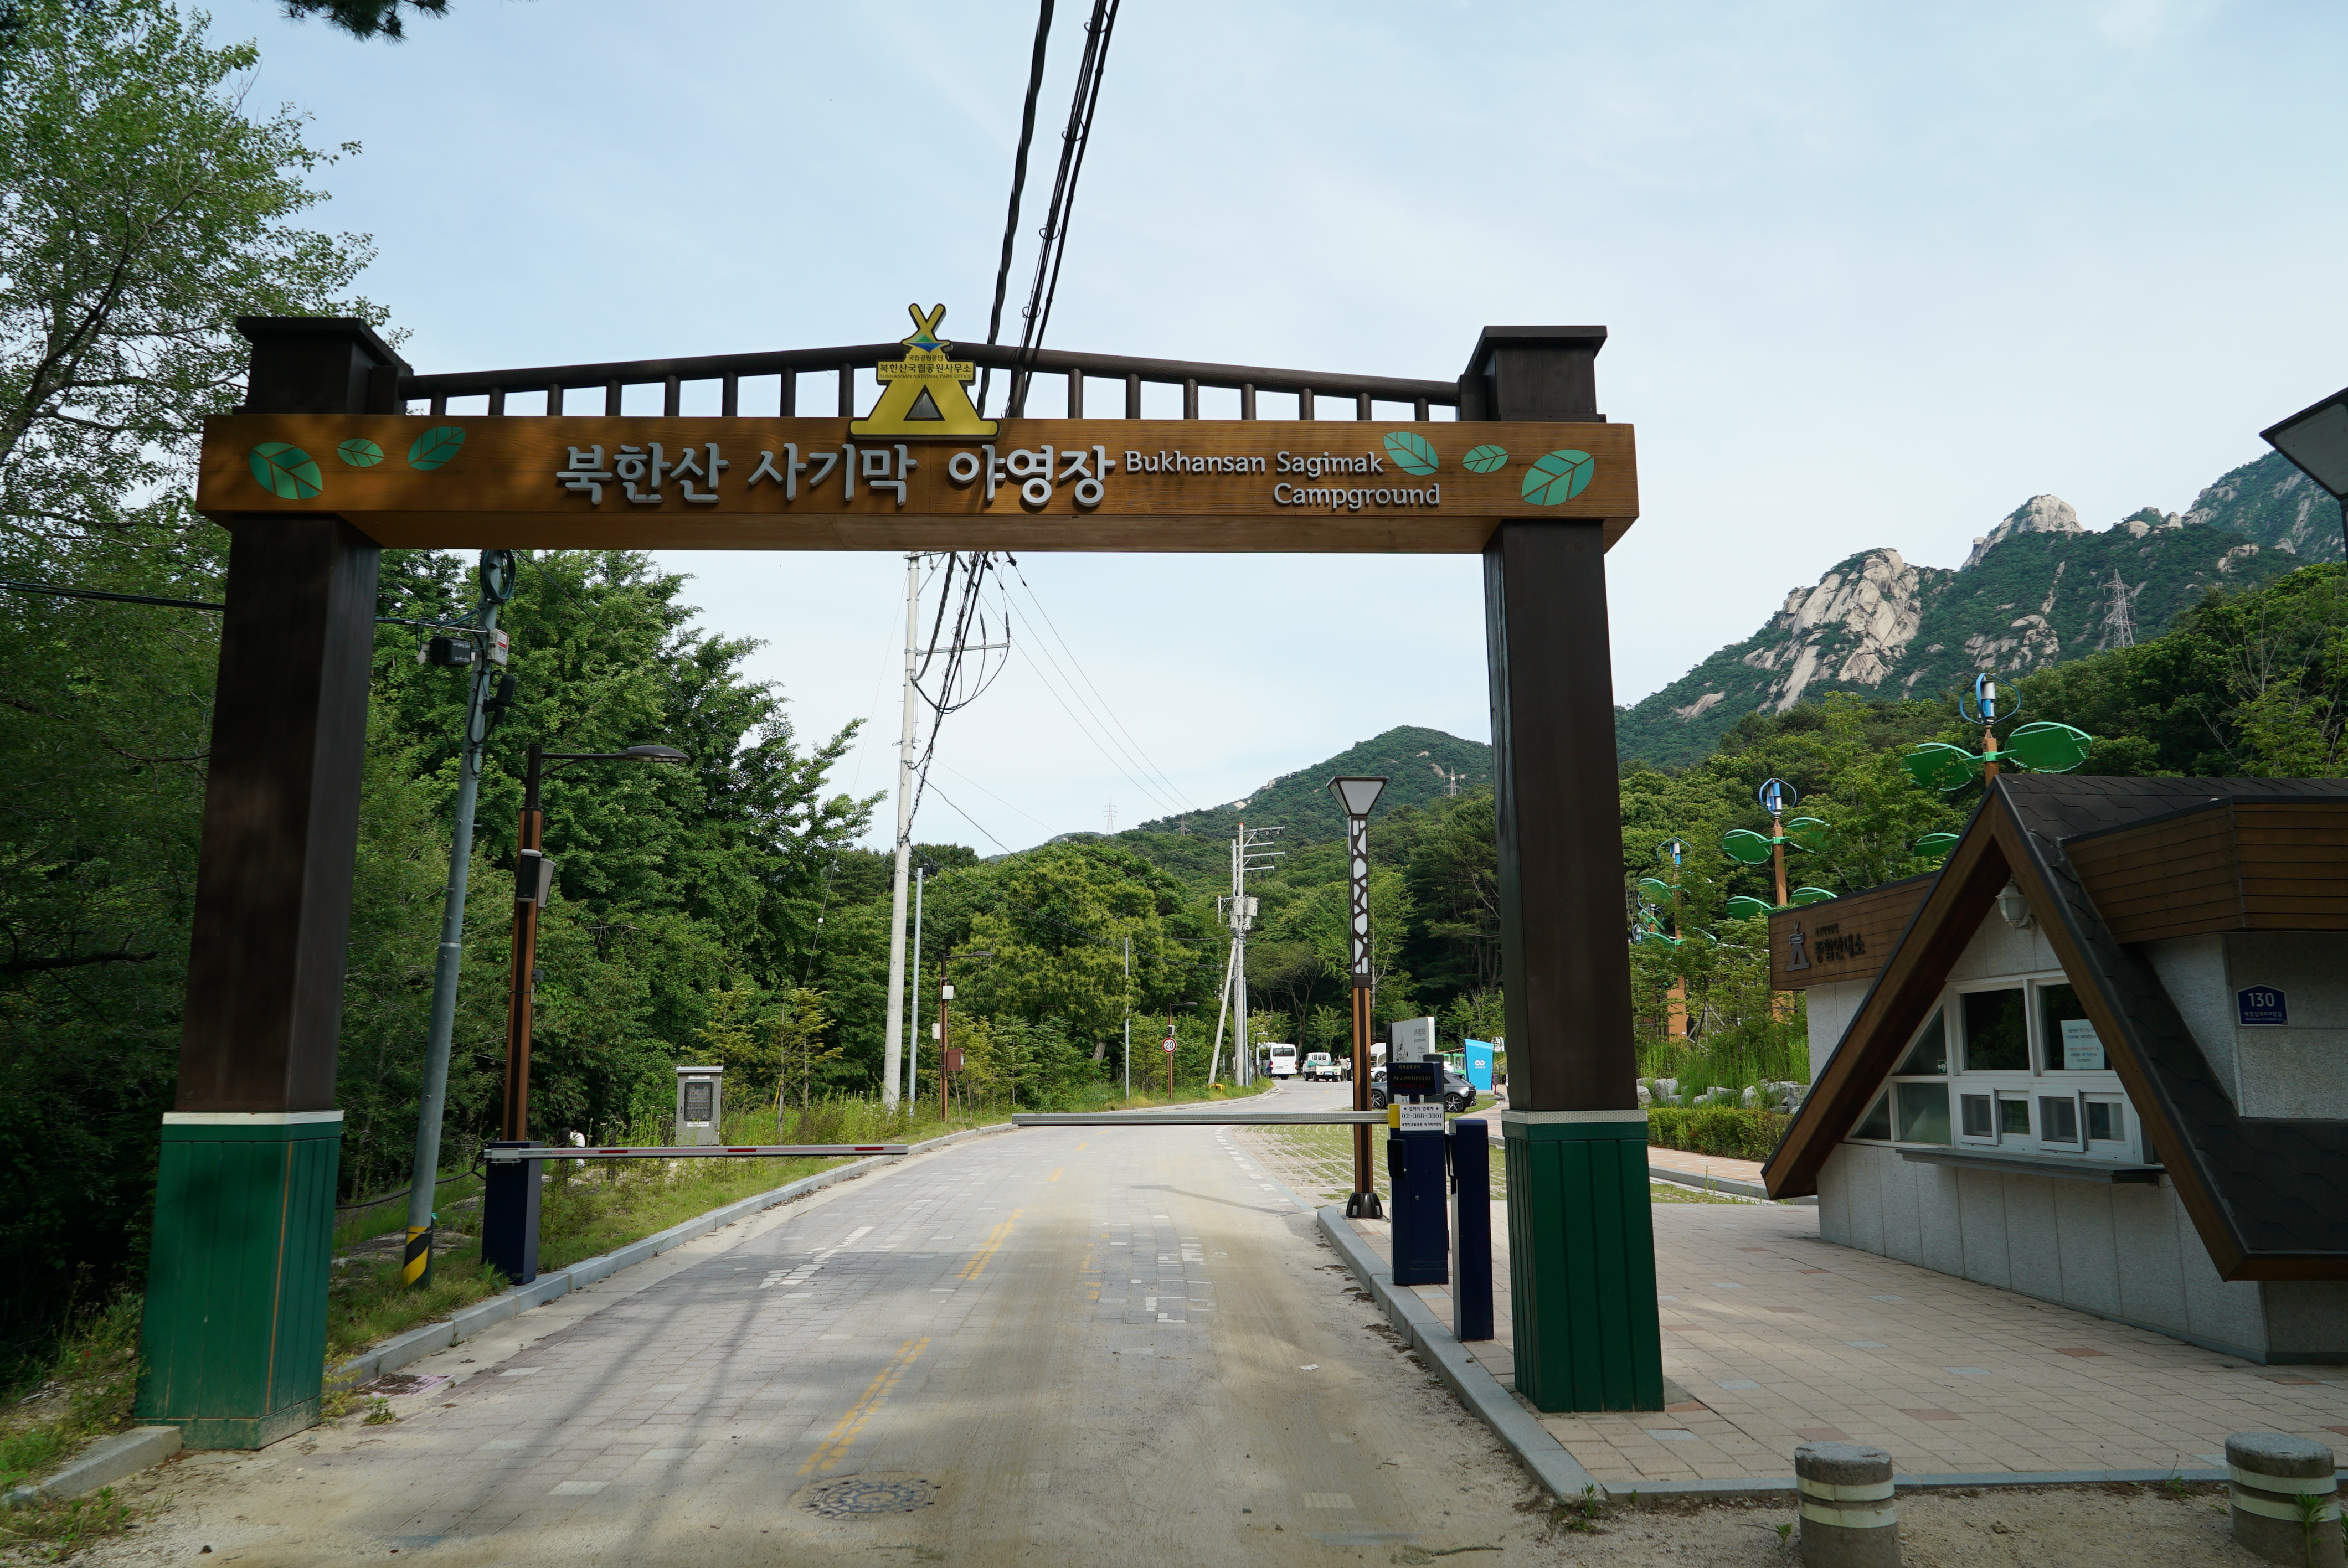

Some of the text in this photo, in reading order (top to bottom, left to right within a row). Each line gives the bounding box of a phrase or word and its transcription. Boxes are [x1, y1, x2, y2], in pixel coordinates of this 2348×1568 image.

[879, 363, 972, 374] 북한산국립공원사무소
[555, 441, 1116, 508] 북한산 사기막 야영장
[1124, 450, 1384, 479] Bukhansan Sagimak
[1273, 482, 1441, 511] Campground
[1814, 933, 1865, 964] 종합안내소
[2248, 992, 2275, 1007] 130
